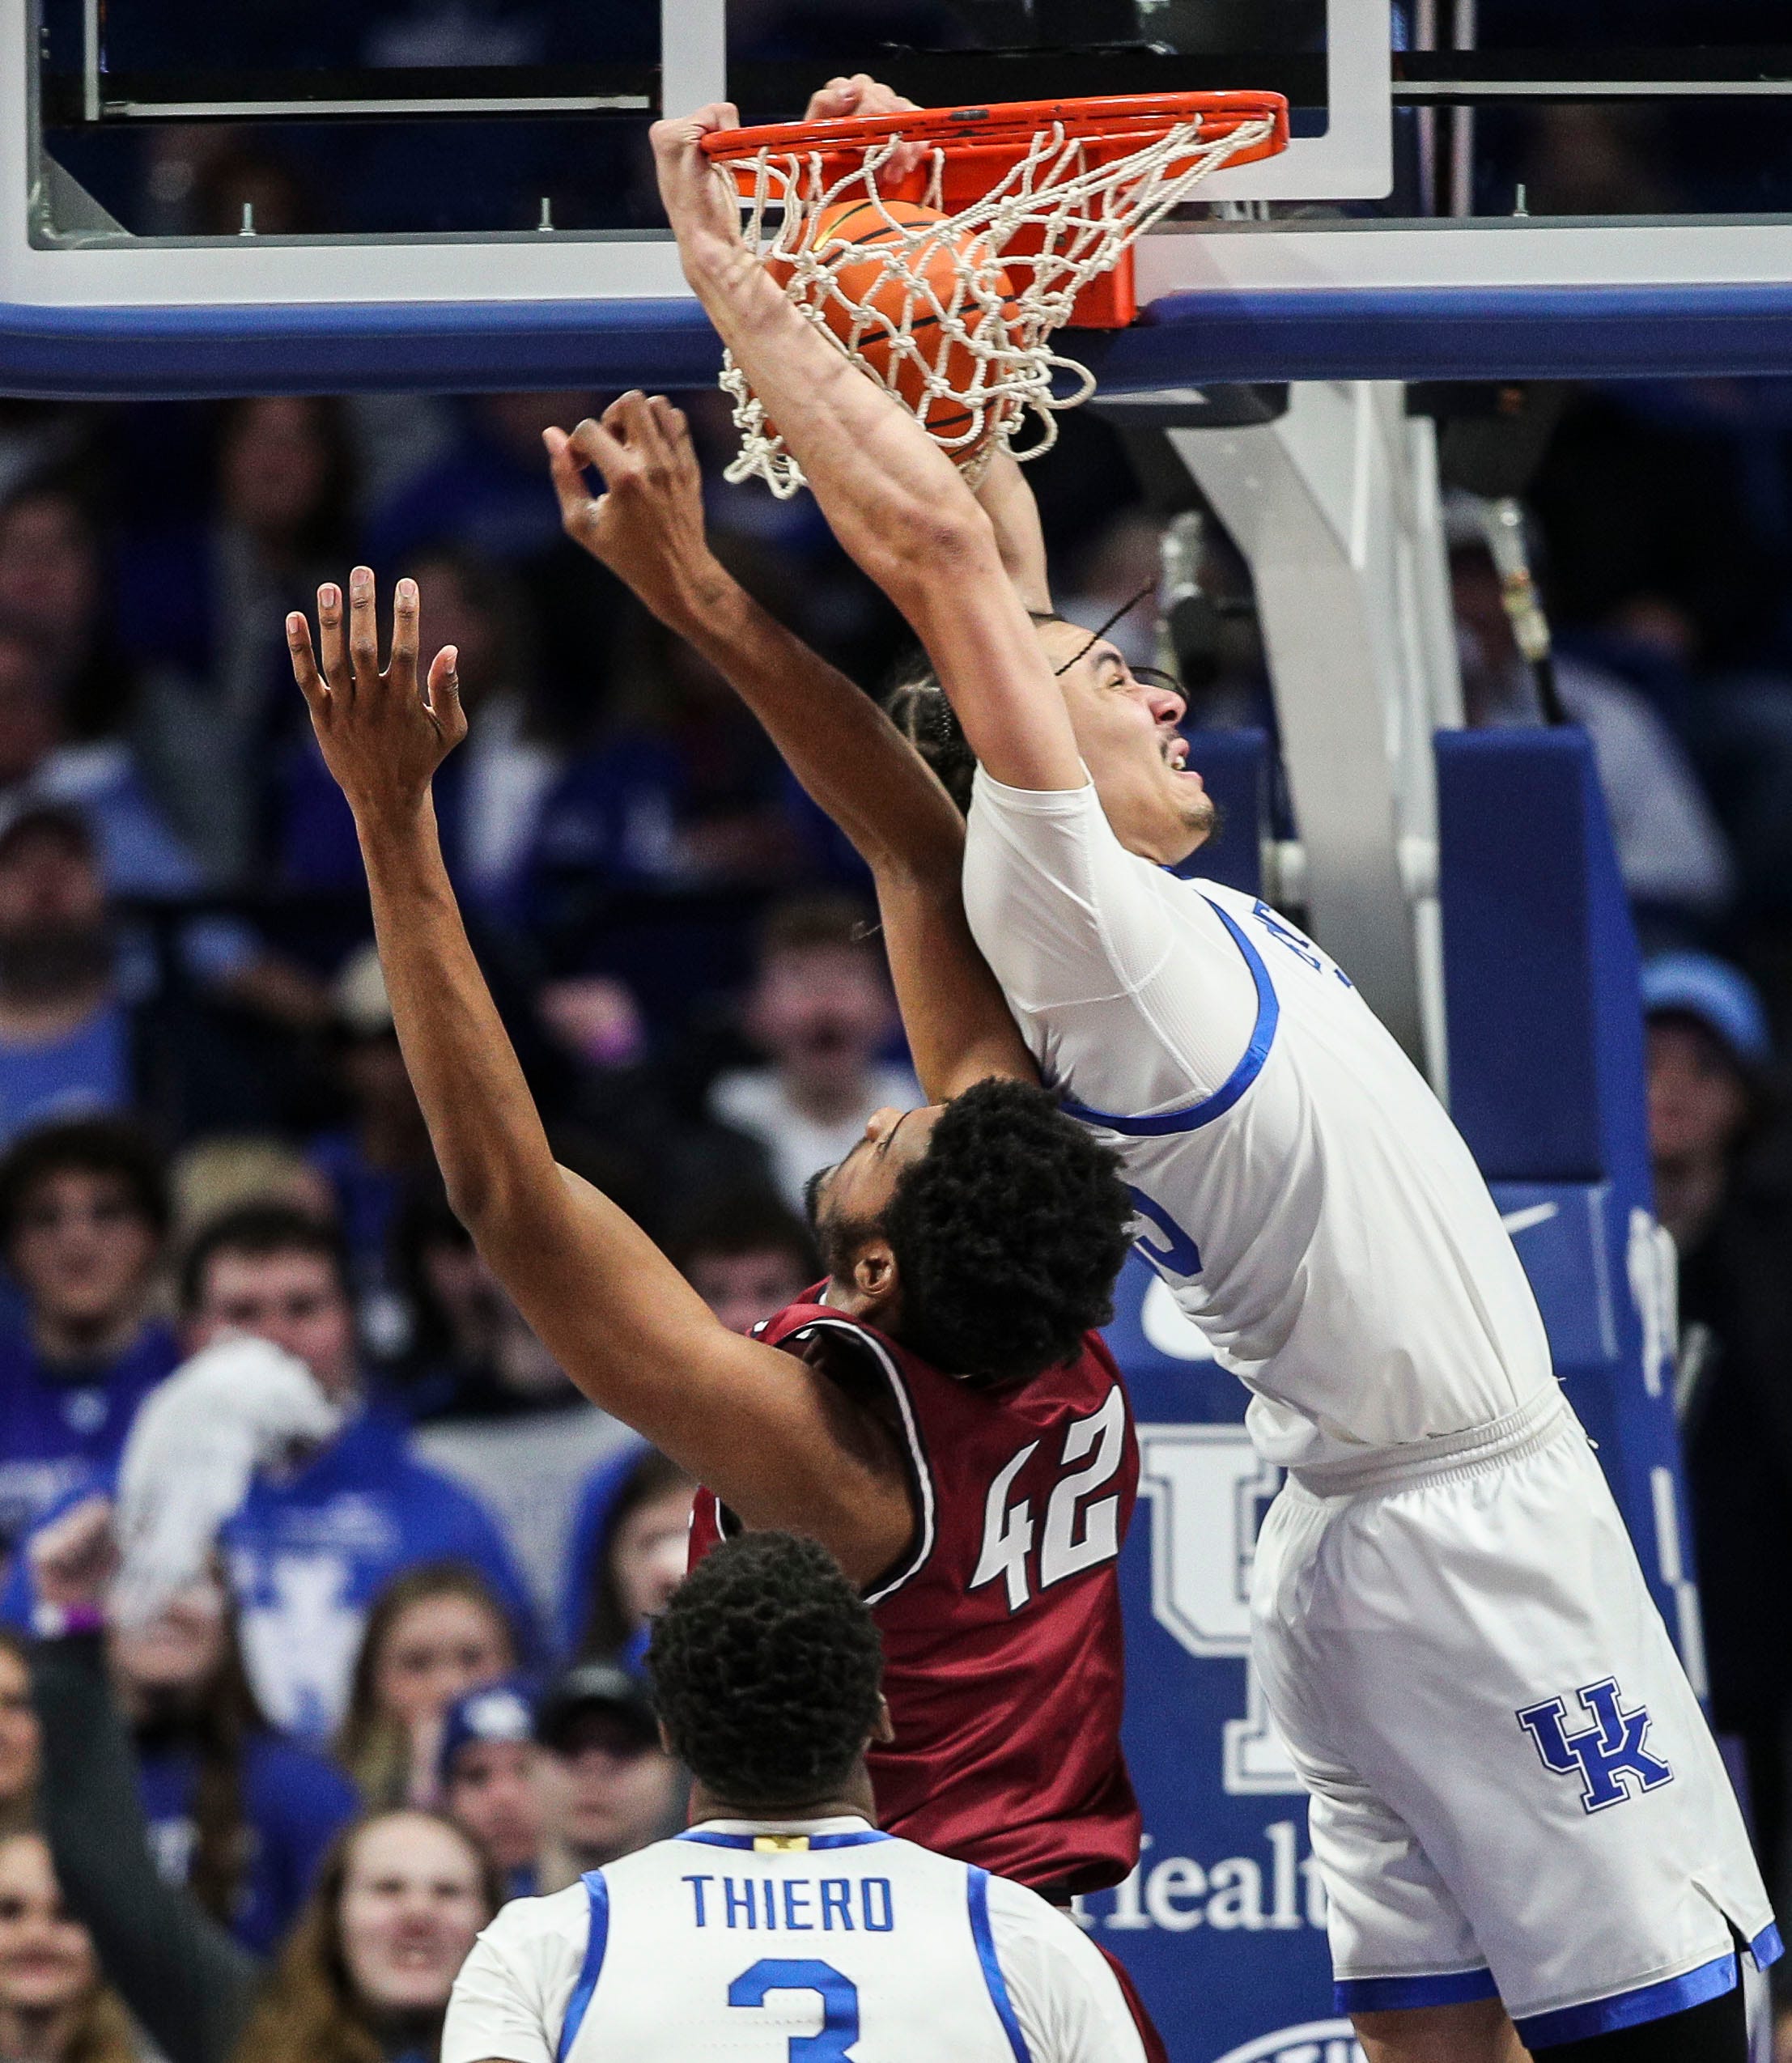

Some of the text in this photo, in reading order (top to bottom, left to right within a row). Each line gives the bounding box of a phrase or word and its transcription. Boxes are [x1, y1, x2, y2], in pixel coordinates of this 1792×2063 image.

[966, 1382, 1126, 1614] 42
[1514, 1675, 1675, 1815] UK
[682, 1874, 894, 1932] THIERO
